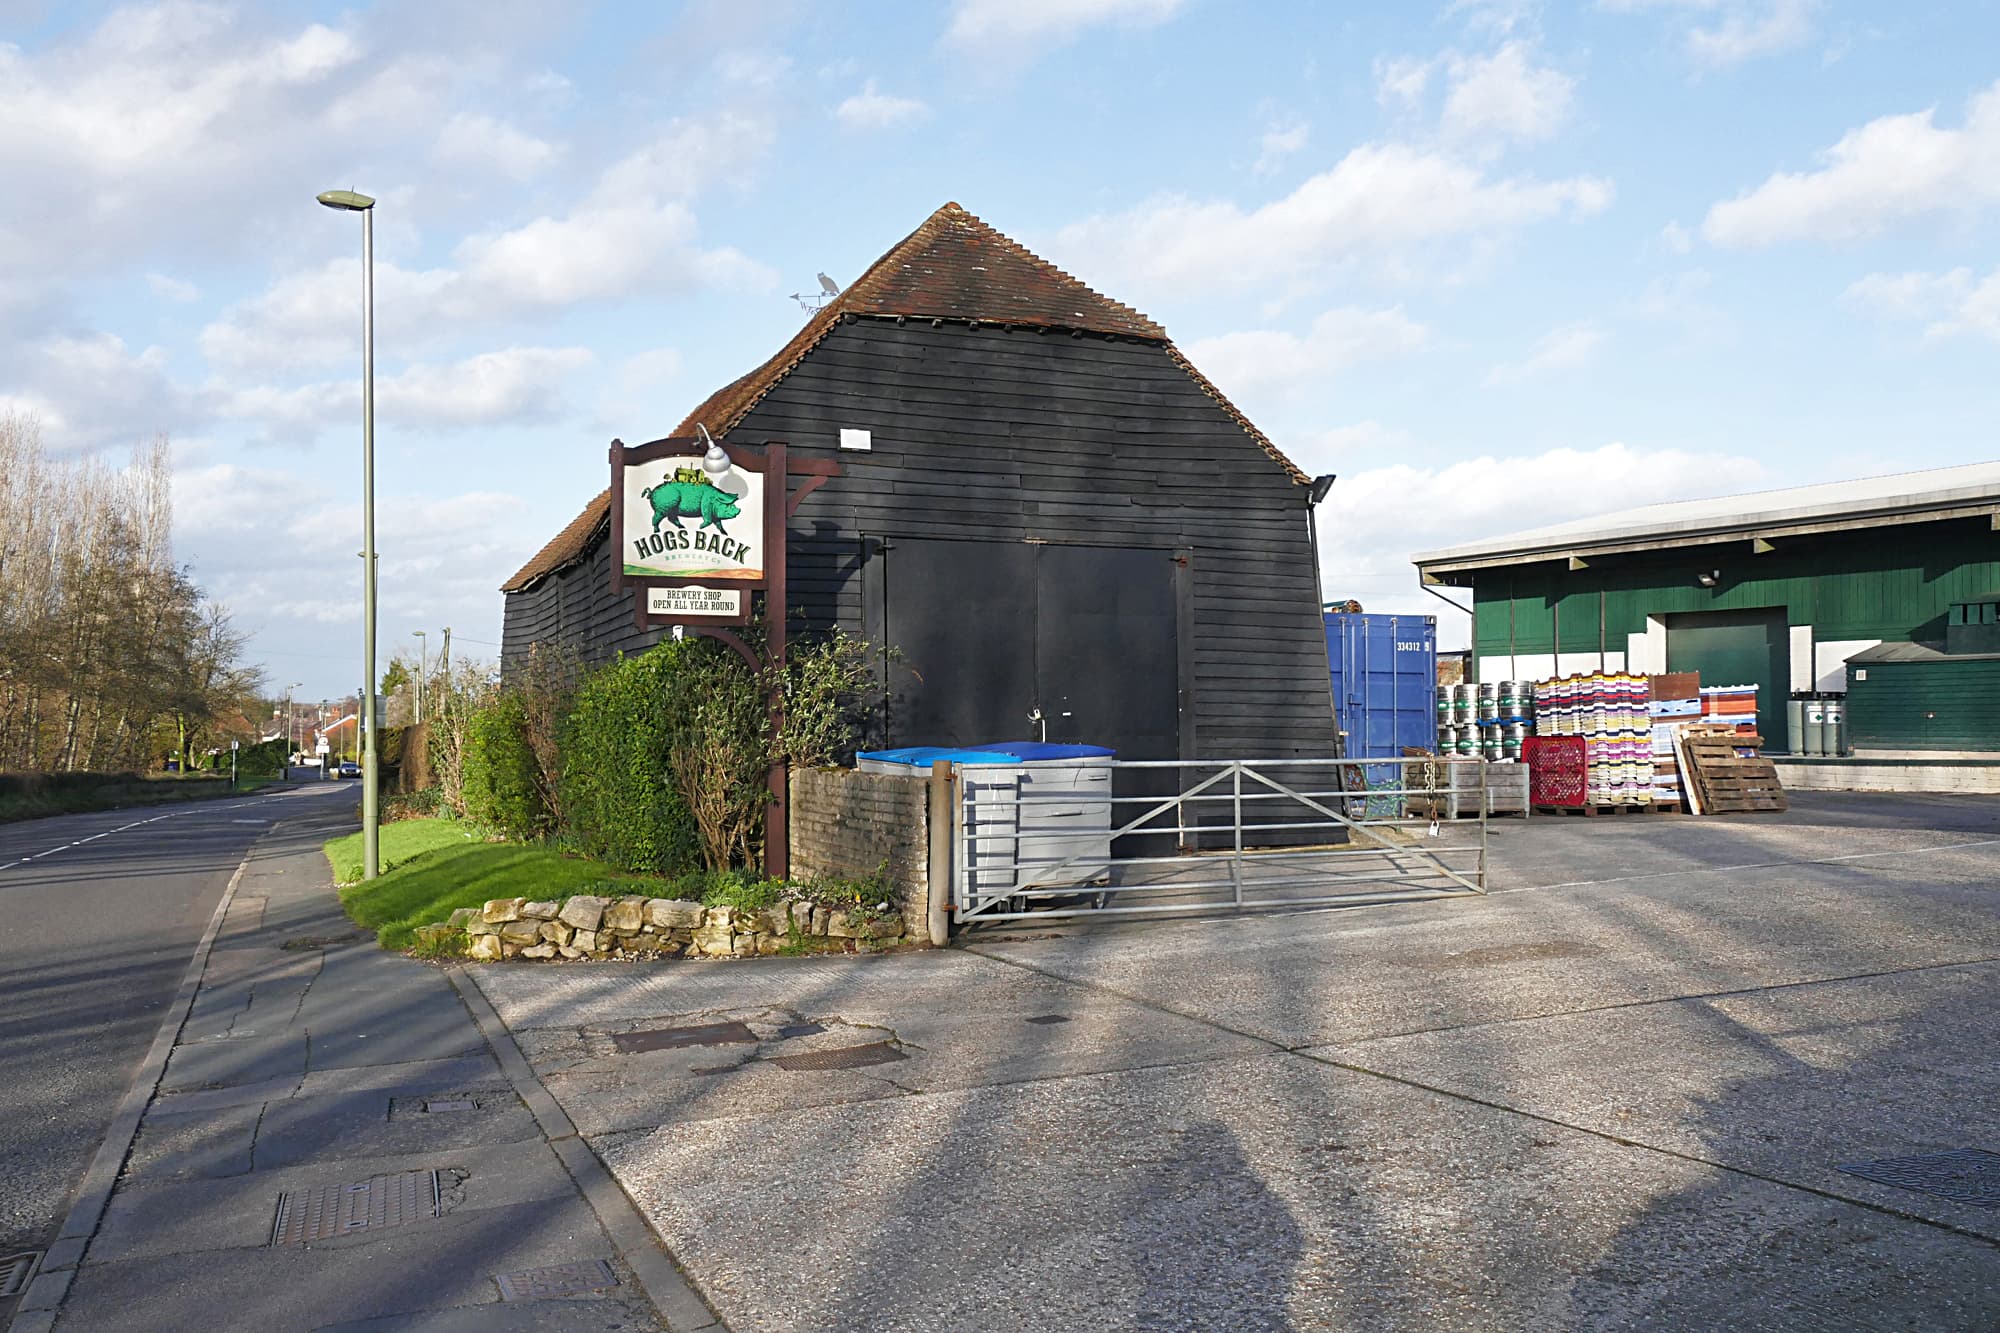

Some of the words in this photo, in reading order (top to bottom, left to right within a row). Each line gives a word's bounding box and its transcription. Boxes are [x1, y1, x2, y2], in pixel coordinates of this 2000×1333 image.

[633, 530, 690, 560] HOGS
[694, 531, 751, 564] BACK
[667, 590, 701, 600] BREWERY
[704, 591, 722, 600] SHOP
[653, 600, 671, 609] OPEN
[674, 600, 687, 610] ALL
[690, 601, 709, 610] YEAR
[711, 602, 735, 611] ROUND
[1397, 641, 1420, 651] 334312
